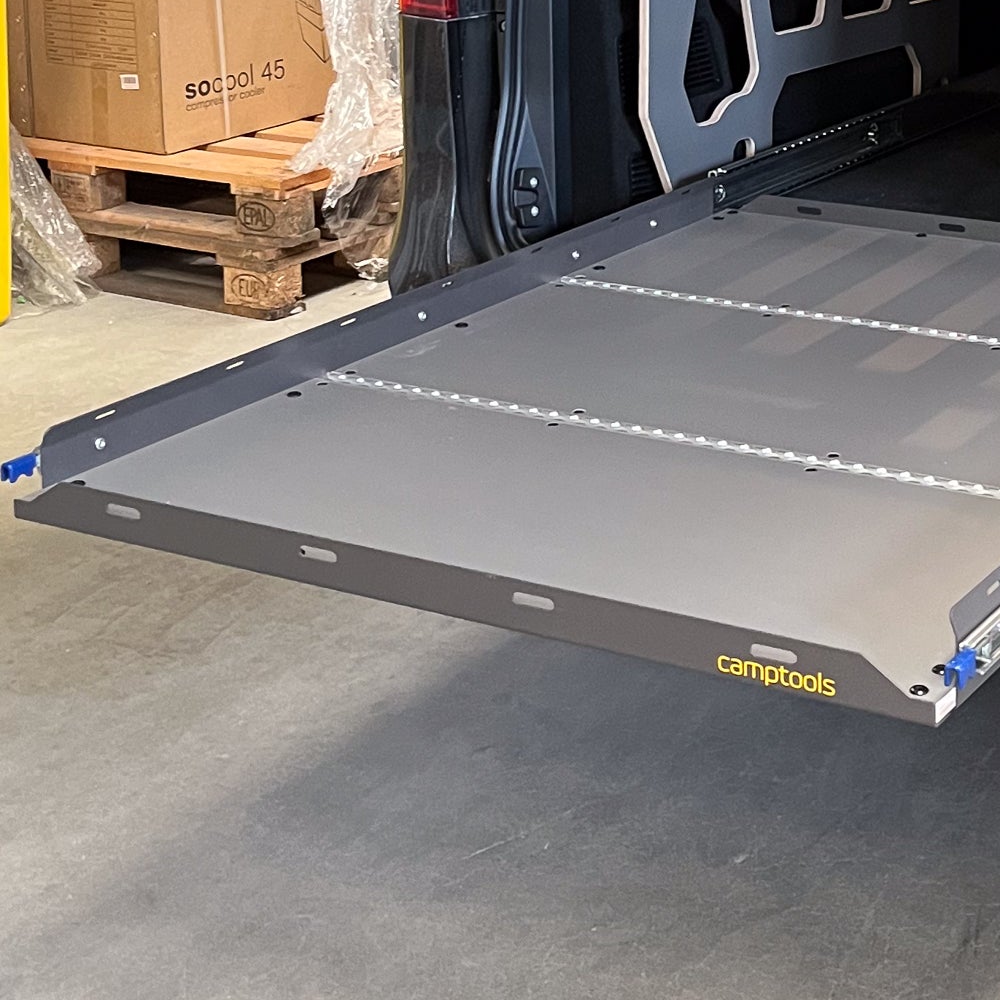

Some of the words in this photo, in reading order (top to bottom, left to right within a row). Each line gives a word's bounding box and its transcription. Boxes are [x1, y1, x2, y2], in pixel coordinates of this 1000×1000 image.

[185, 63, 254, 100] socool
[261, 59, 285, 81] 45
[243, 206, 271, 227] EPAL
[717, 654, 836, 697] camptools
